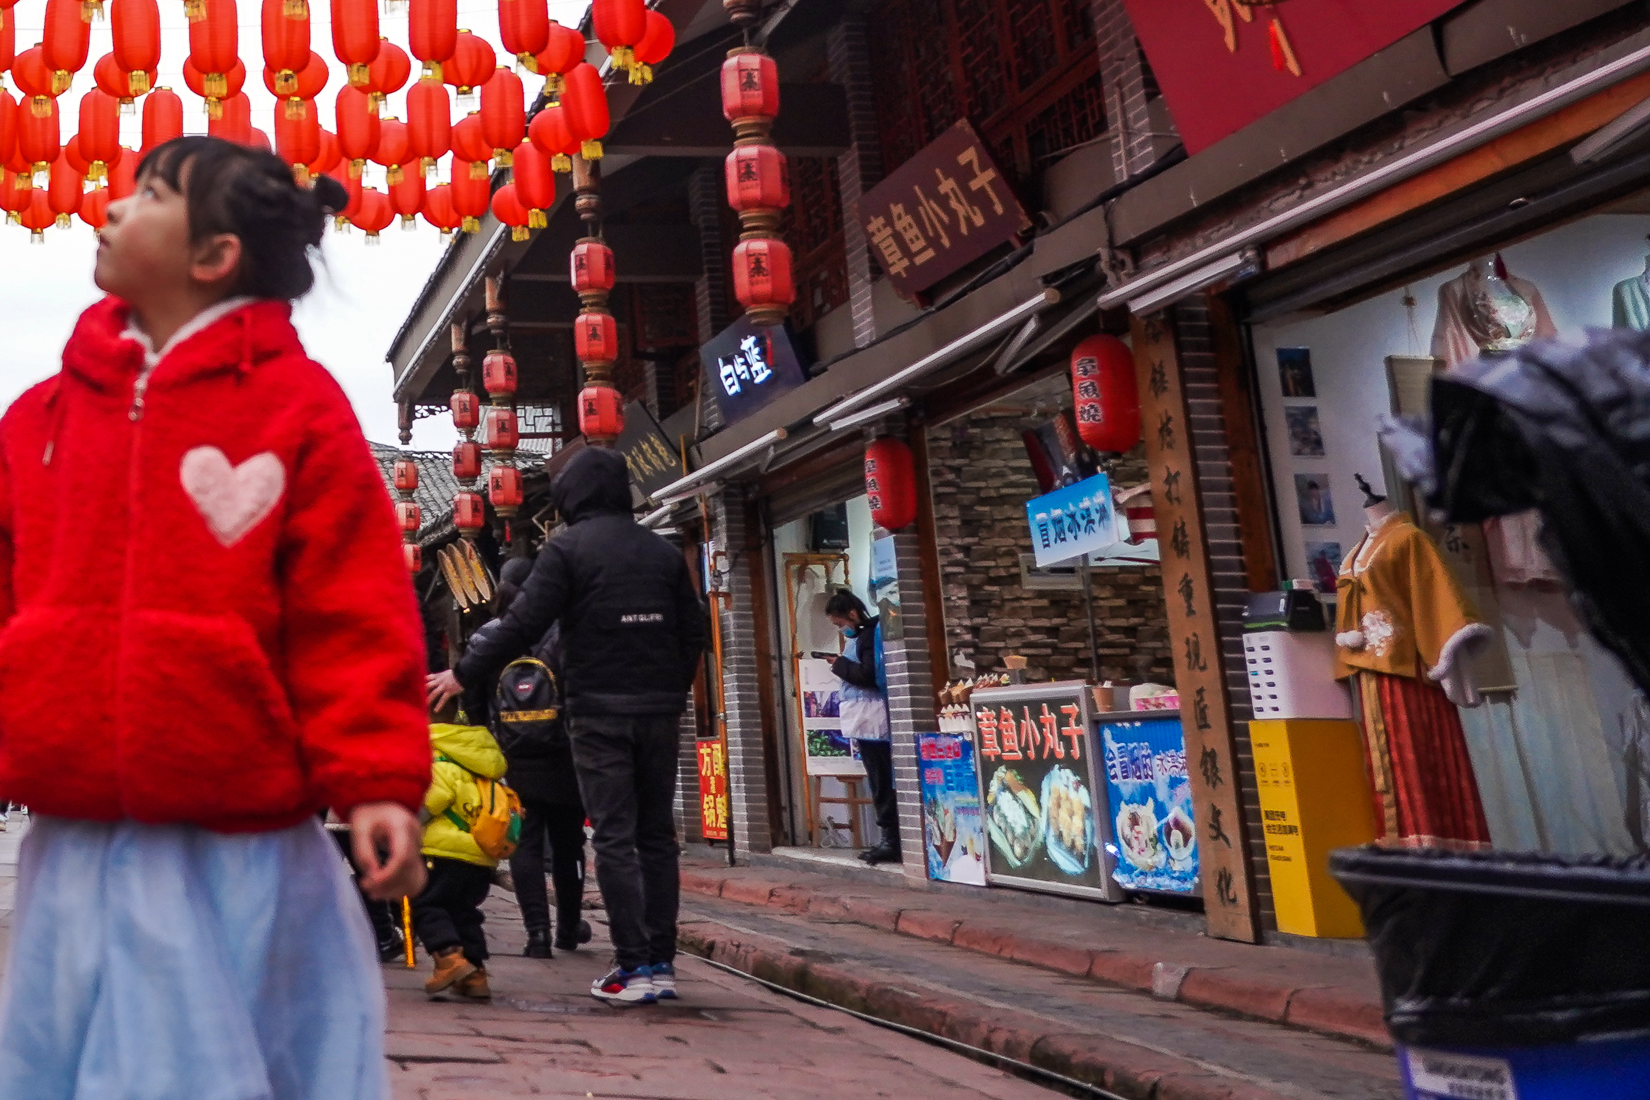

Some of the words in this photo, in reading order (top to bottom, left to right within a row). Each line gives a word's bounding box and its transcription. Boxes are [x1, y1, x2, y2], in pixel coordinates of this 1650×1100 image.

[866, 145, 1004, 278] 章鱼小丸子
[976, 702, 1085, 762] 章鱼小丸子
